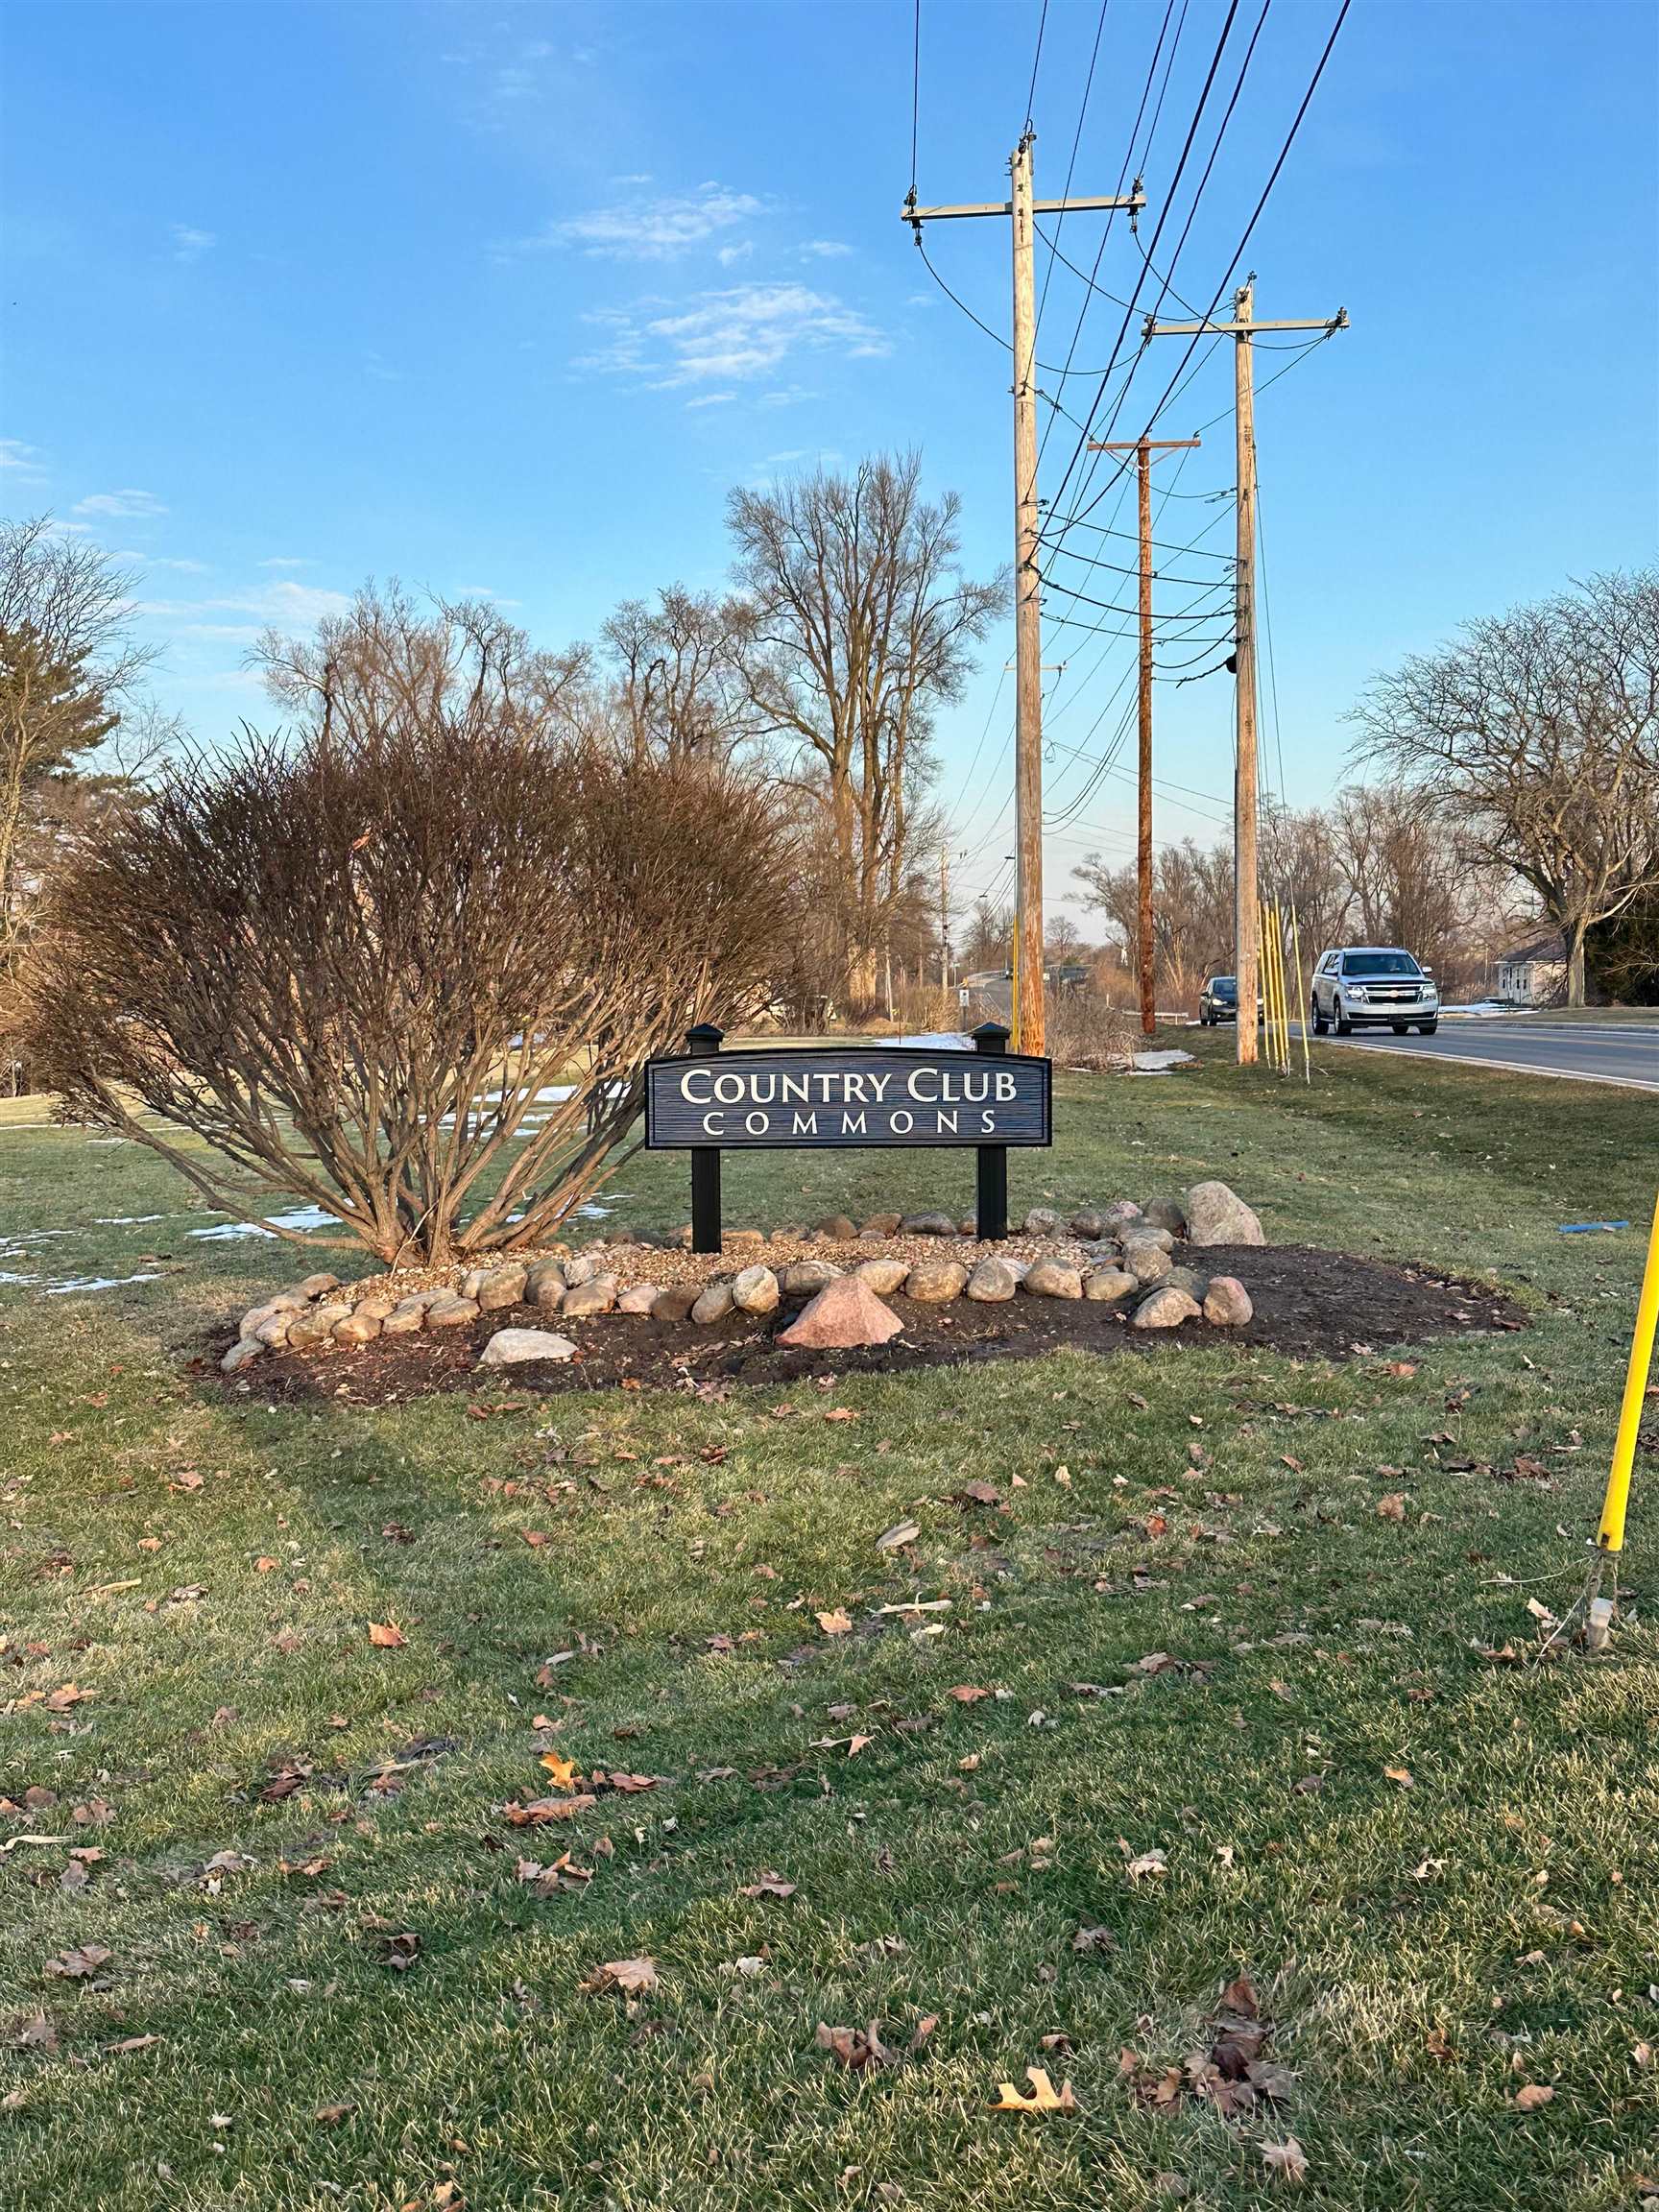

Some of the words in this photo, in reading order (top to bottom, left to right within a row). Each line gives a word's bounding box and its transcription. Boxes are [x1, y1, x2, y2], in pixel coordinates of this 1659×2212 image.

[681, 1069, 892, 1104] COUNTRY
[907, 1068, 1017, 1102] CLUB
[703, 1110, 996, 1136] COMMONS
